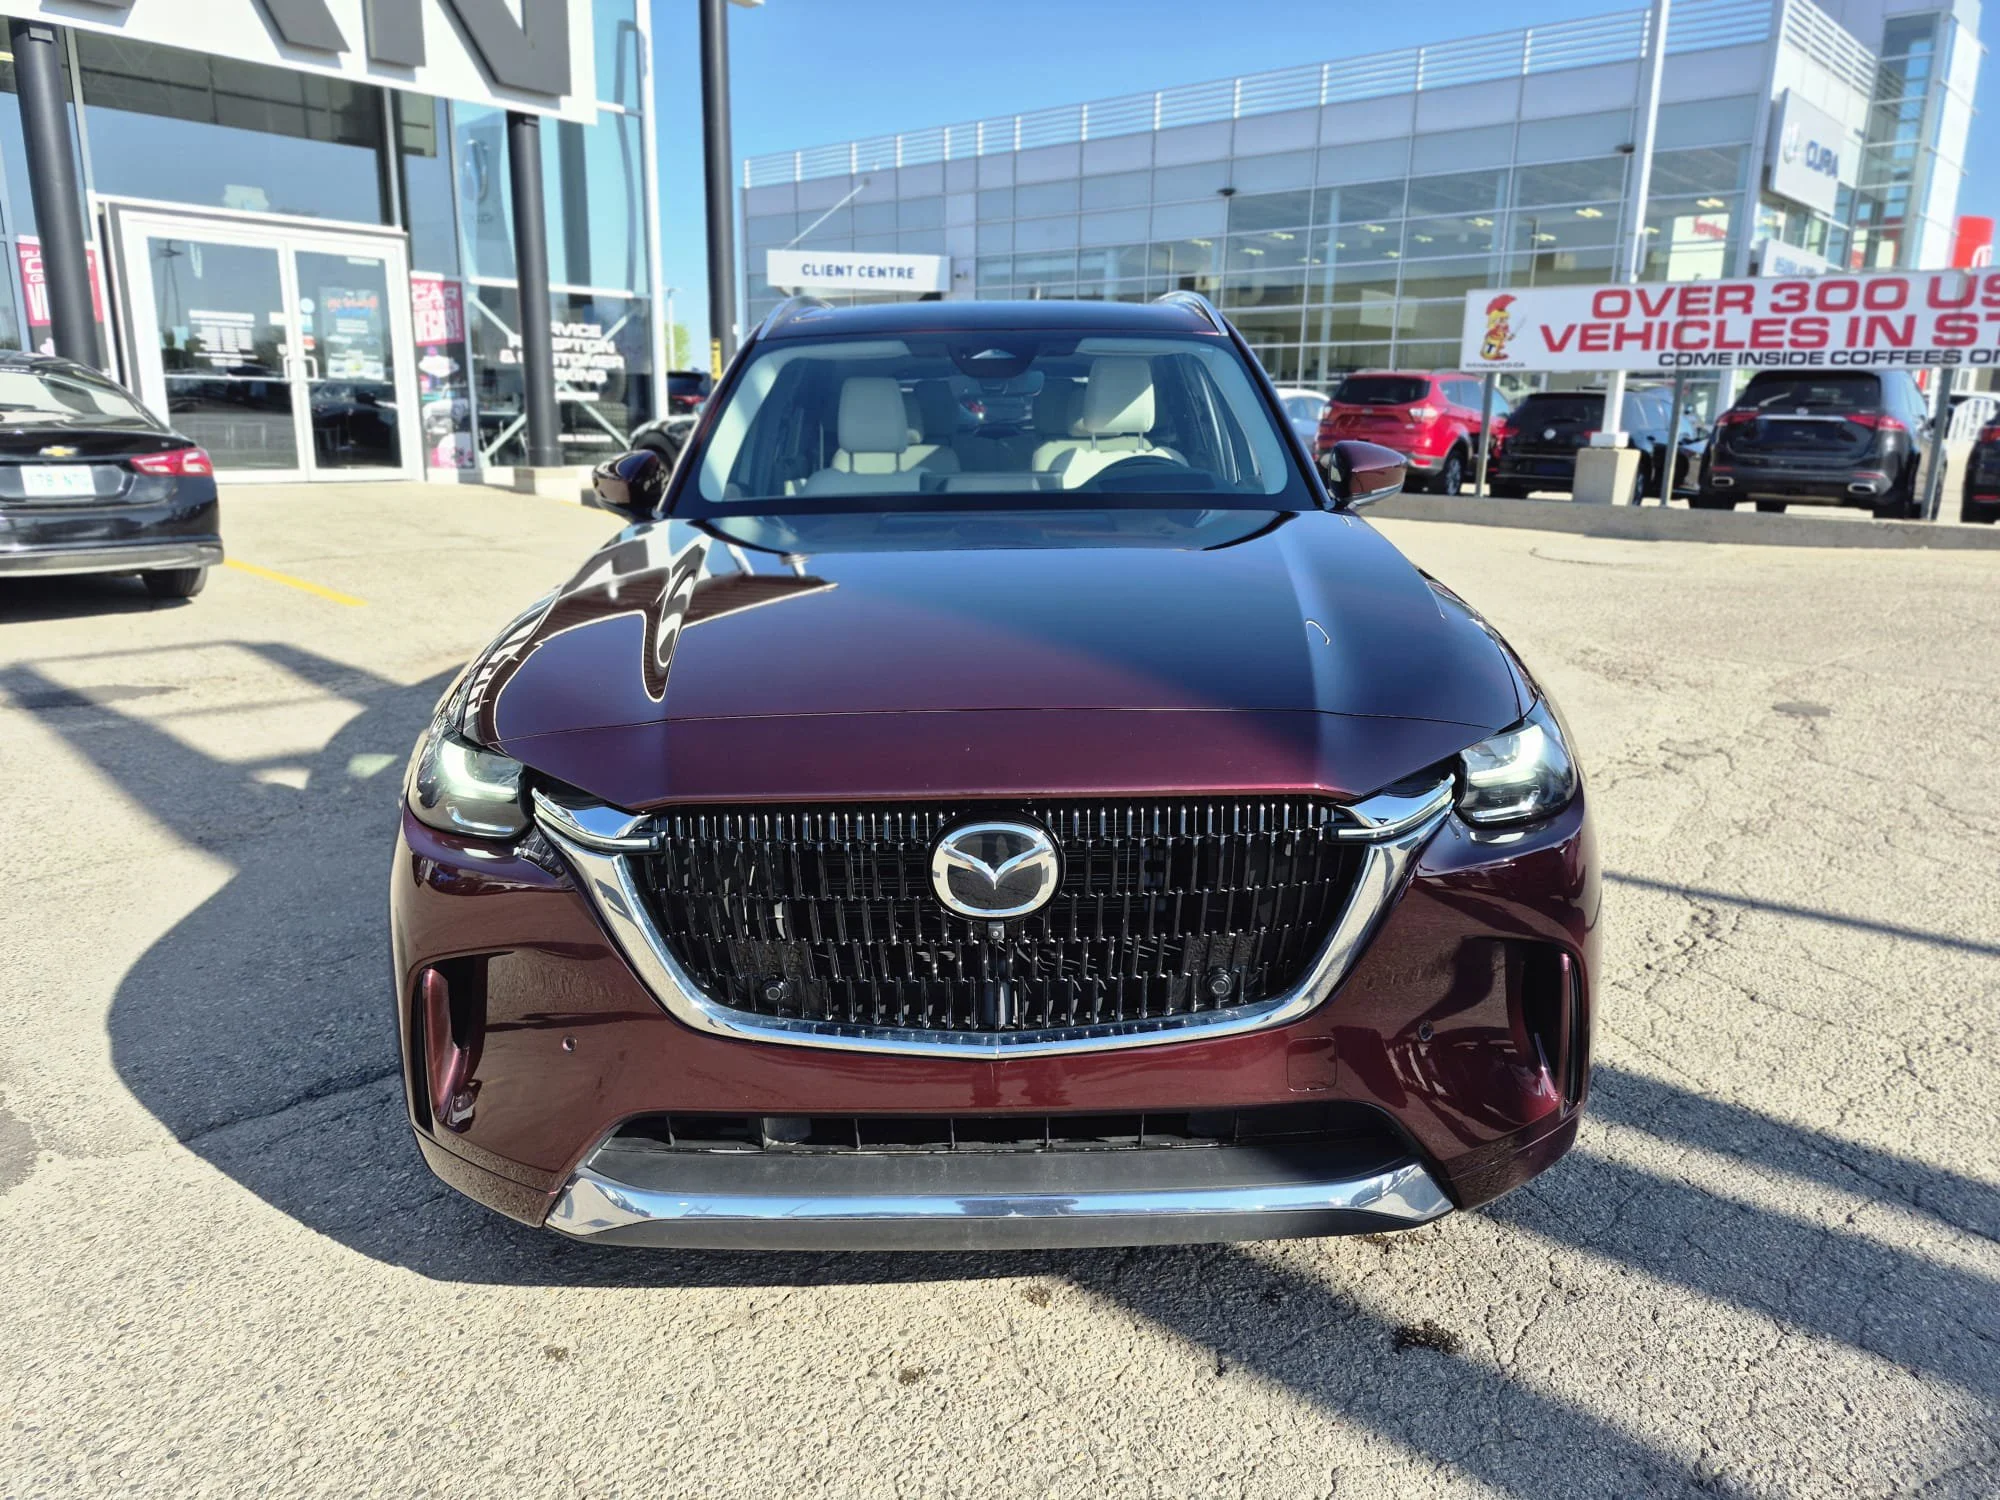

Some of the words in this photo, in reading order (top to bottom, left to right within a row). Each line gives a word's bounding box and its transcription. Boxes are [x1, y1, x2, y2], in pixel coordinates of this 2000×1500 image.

[801, 263, 854, 278] CLIENT
[857, 265, 916, 280] CENTRE
[1591, 283, 1756, 320] OVER
[1769, 277, 1910, 314] 300
[1539, 316, 1830, 354] VEHICLES
[1845, 314, 1917, 349] IN
[1657, 352, 1732, 367] COME
[1737, 350, 1825, 366] INSIDE
[1829, 349, 1962, 366] COFFEES
